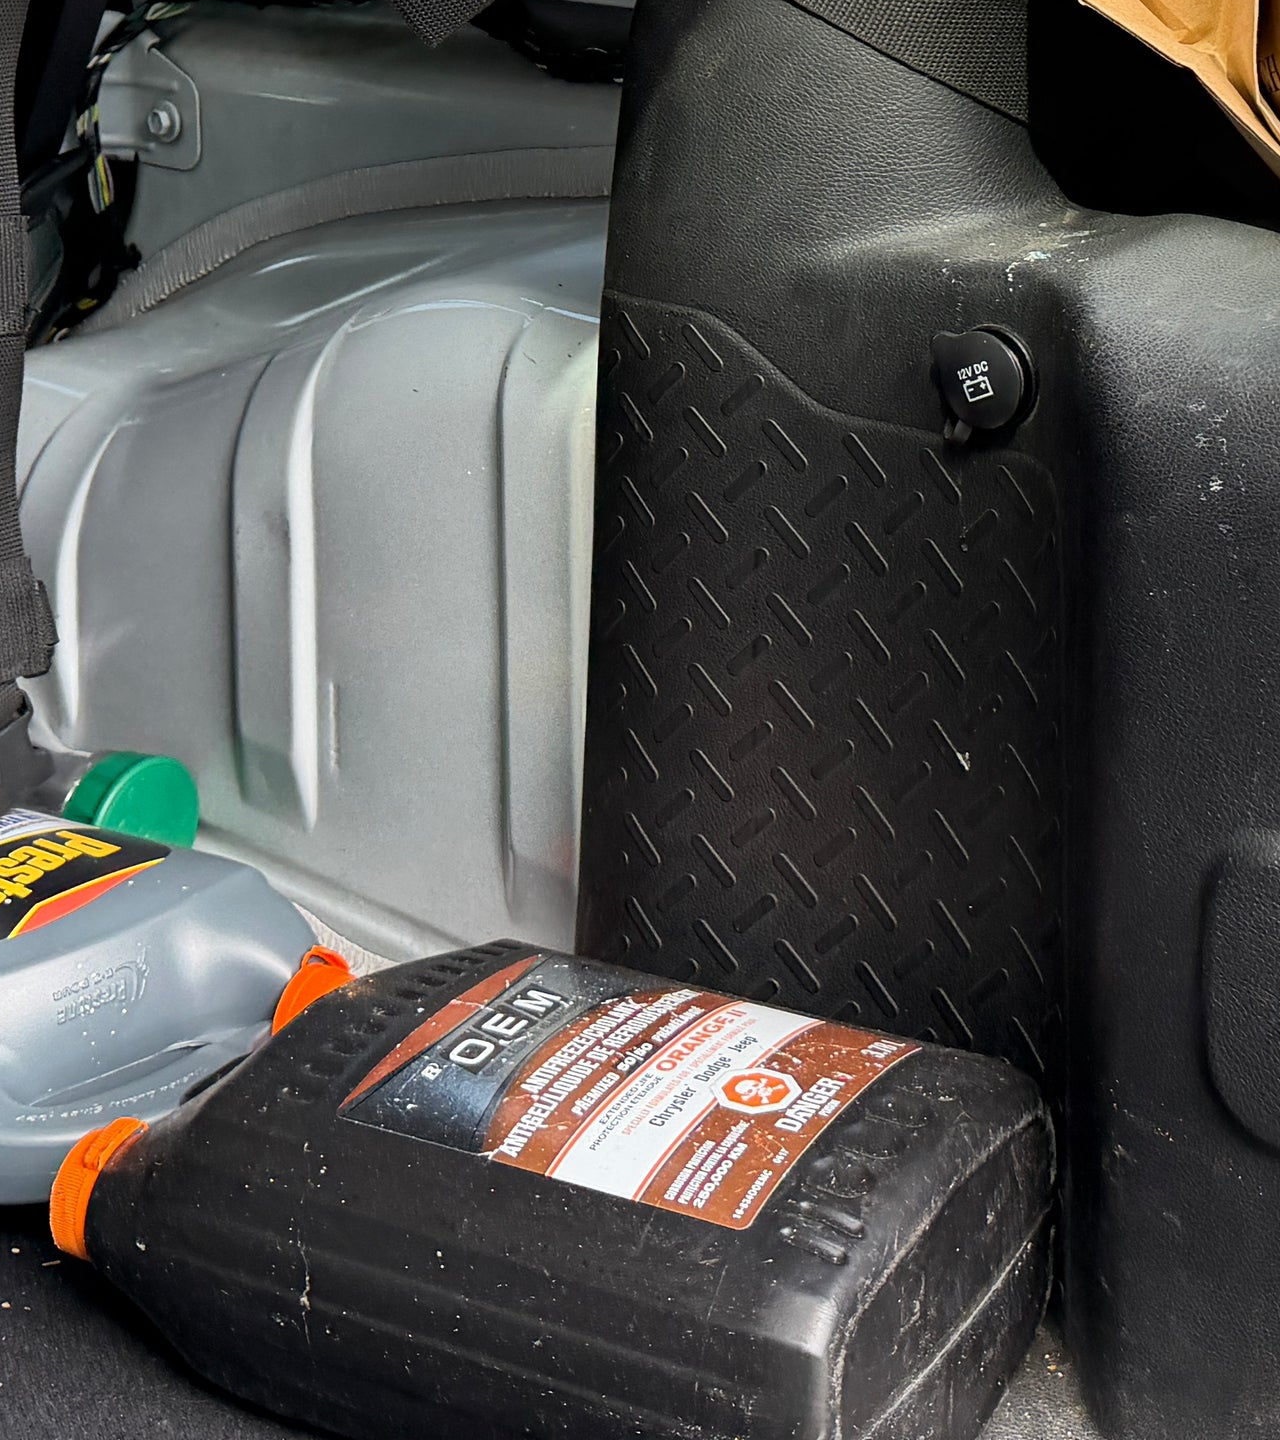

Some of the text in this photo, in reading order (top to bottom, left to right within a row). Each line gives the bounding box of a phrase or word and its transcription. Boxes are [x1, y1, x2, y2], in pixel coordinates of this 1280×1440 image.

[957, 360, 989, 380] 12V DC
[449, 989, 562, 1065] OEM
[655, 1017, 736, 1072] ORANGE
[499, 1058, 601, 1157] ANTIGEL/LIQUIDE
[587, 1045, 615, 1065] DE
[571, 1071, 620, 1116] PREMIXED
[648, 1034, 759, 1128] Chrysler Dodge Jeep
[774, 1076, 846, 1133] DANGER
[589, 1102, 634, 1151] PROTECTION
[692, 1142, 748, 1209] 250,000 KM
